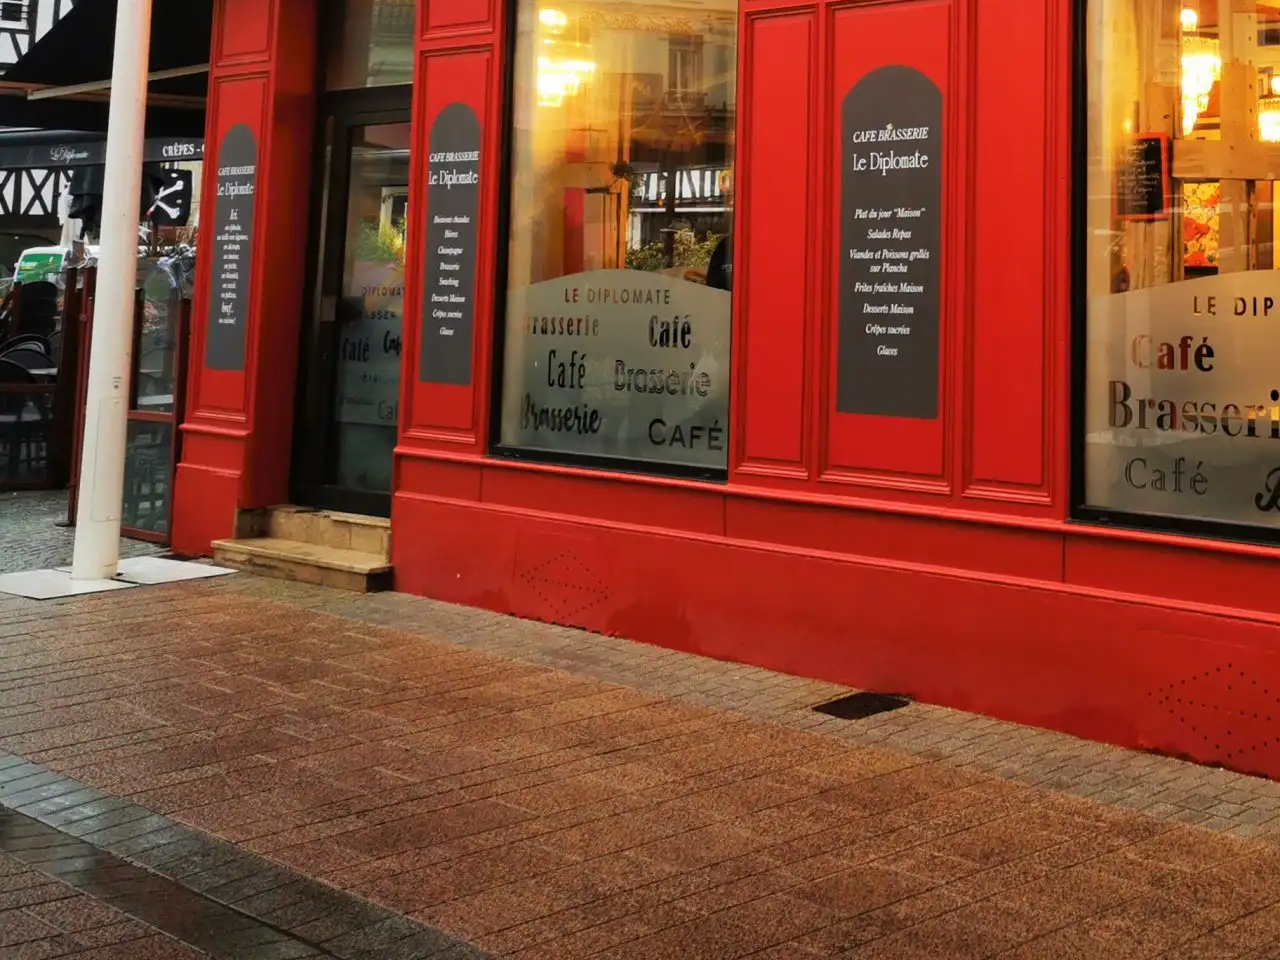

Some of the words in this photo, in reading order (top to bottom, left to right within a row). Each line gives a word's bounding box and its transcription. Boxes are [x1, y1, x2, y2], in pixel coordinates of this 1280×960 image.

[853, 130, 877, 143] CAFE
[878, 126, 929, 142] BRASSERIE
[162, 142, 195, 157] CRÊPES
[445, 150, 480, 162] BRASSERIE
[853, 153, 867, 171] Le
[869, 149, 929, 176] Diplomate
[428, 170, 438, 185] Le
[439, 168, 479, 189] Diplomate
[854, 208, 868, 219] Plat
[868, 208, 877, 219] du
[876, 208, 892, 220] jour
[867, 228, 891, 239] Salades
[892, 227, 912, 240] Repas
[849, 248, 874, 259] Viandes
[874, 249, 881, 259] et
[881, 248, 909, 259] Poissons
[869, 264, 881, 273] sur
[881, 262, 908, 273] Plancha
[565, 287, 579, 303] LE
[587, 287, 671, 305] DIPLOMATE
[854, 282, 872, 292] Frites
[899, 282, 924, 293] Maison
[863, 302, 888, 313] Desserts
[889, 303, 914, 314] Maison
[1192, 295, 1217, 316] LE
[649, 314, 692, 349] Café
[865, 323, 886, 336] Crêpes
[1132, 335, 1215, 372] Café
[547, 348, 587, 389] Café
[613, 359, 712, 397] Brasserie
[519, 392, 602, 435] Brasserie
[648, 417, 724, 451] CAFÉ
[1124, 456, 1209, 496] Café
